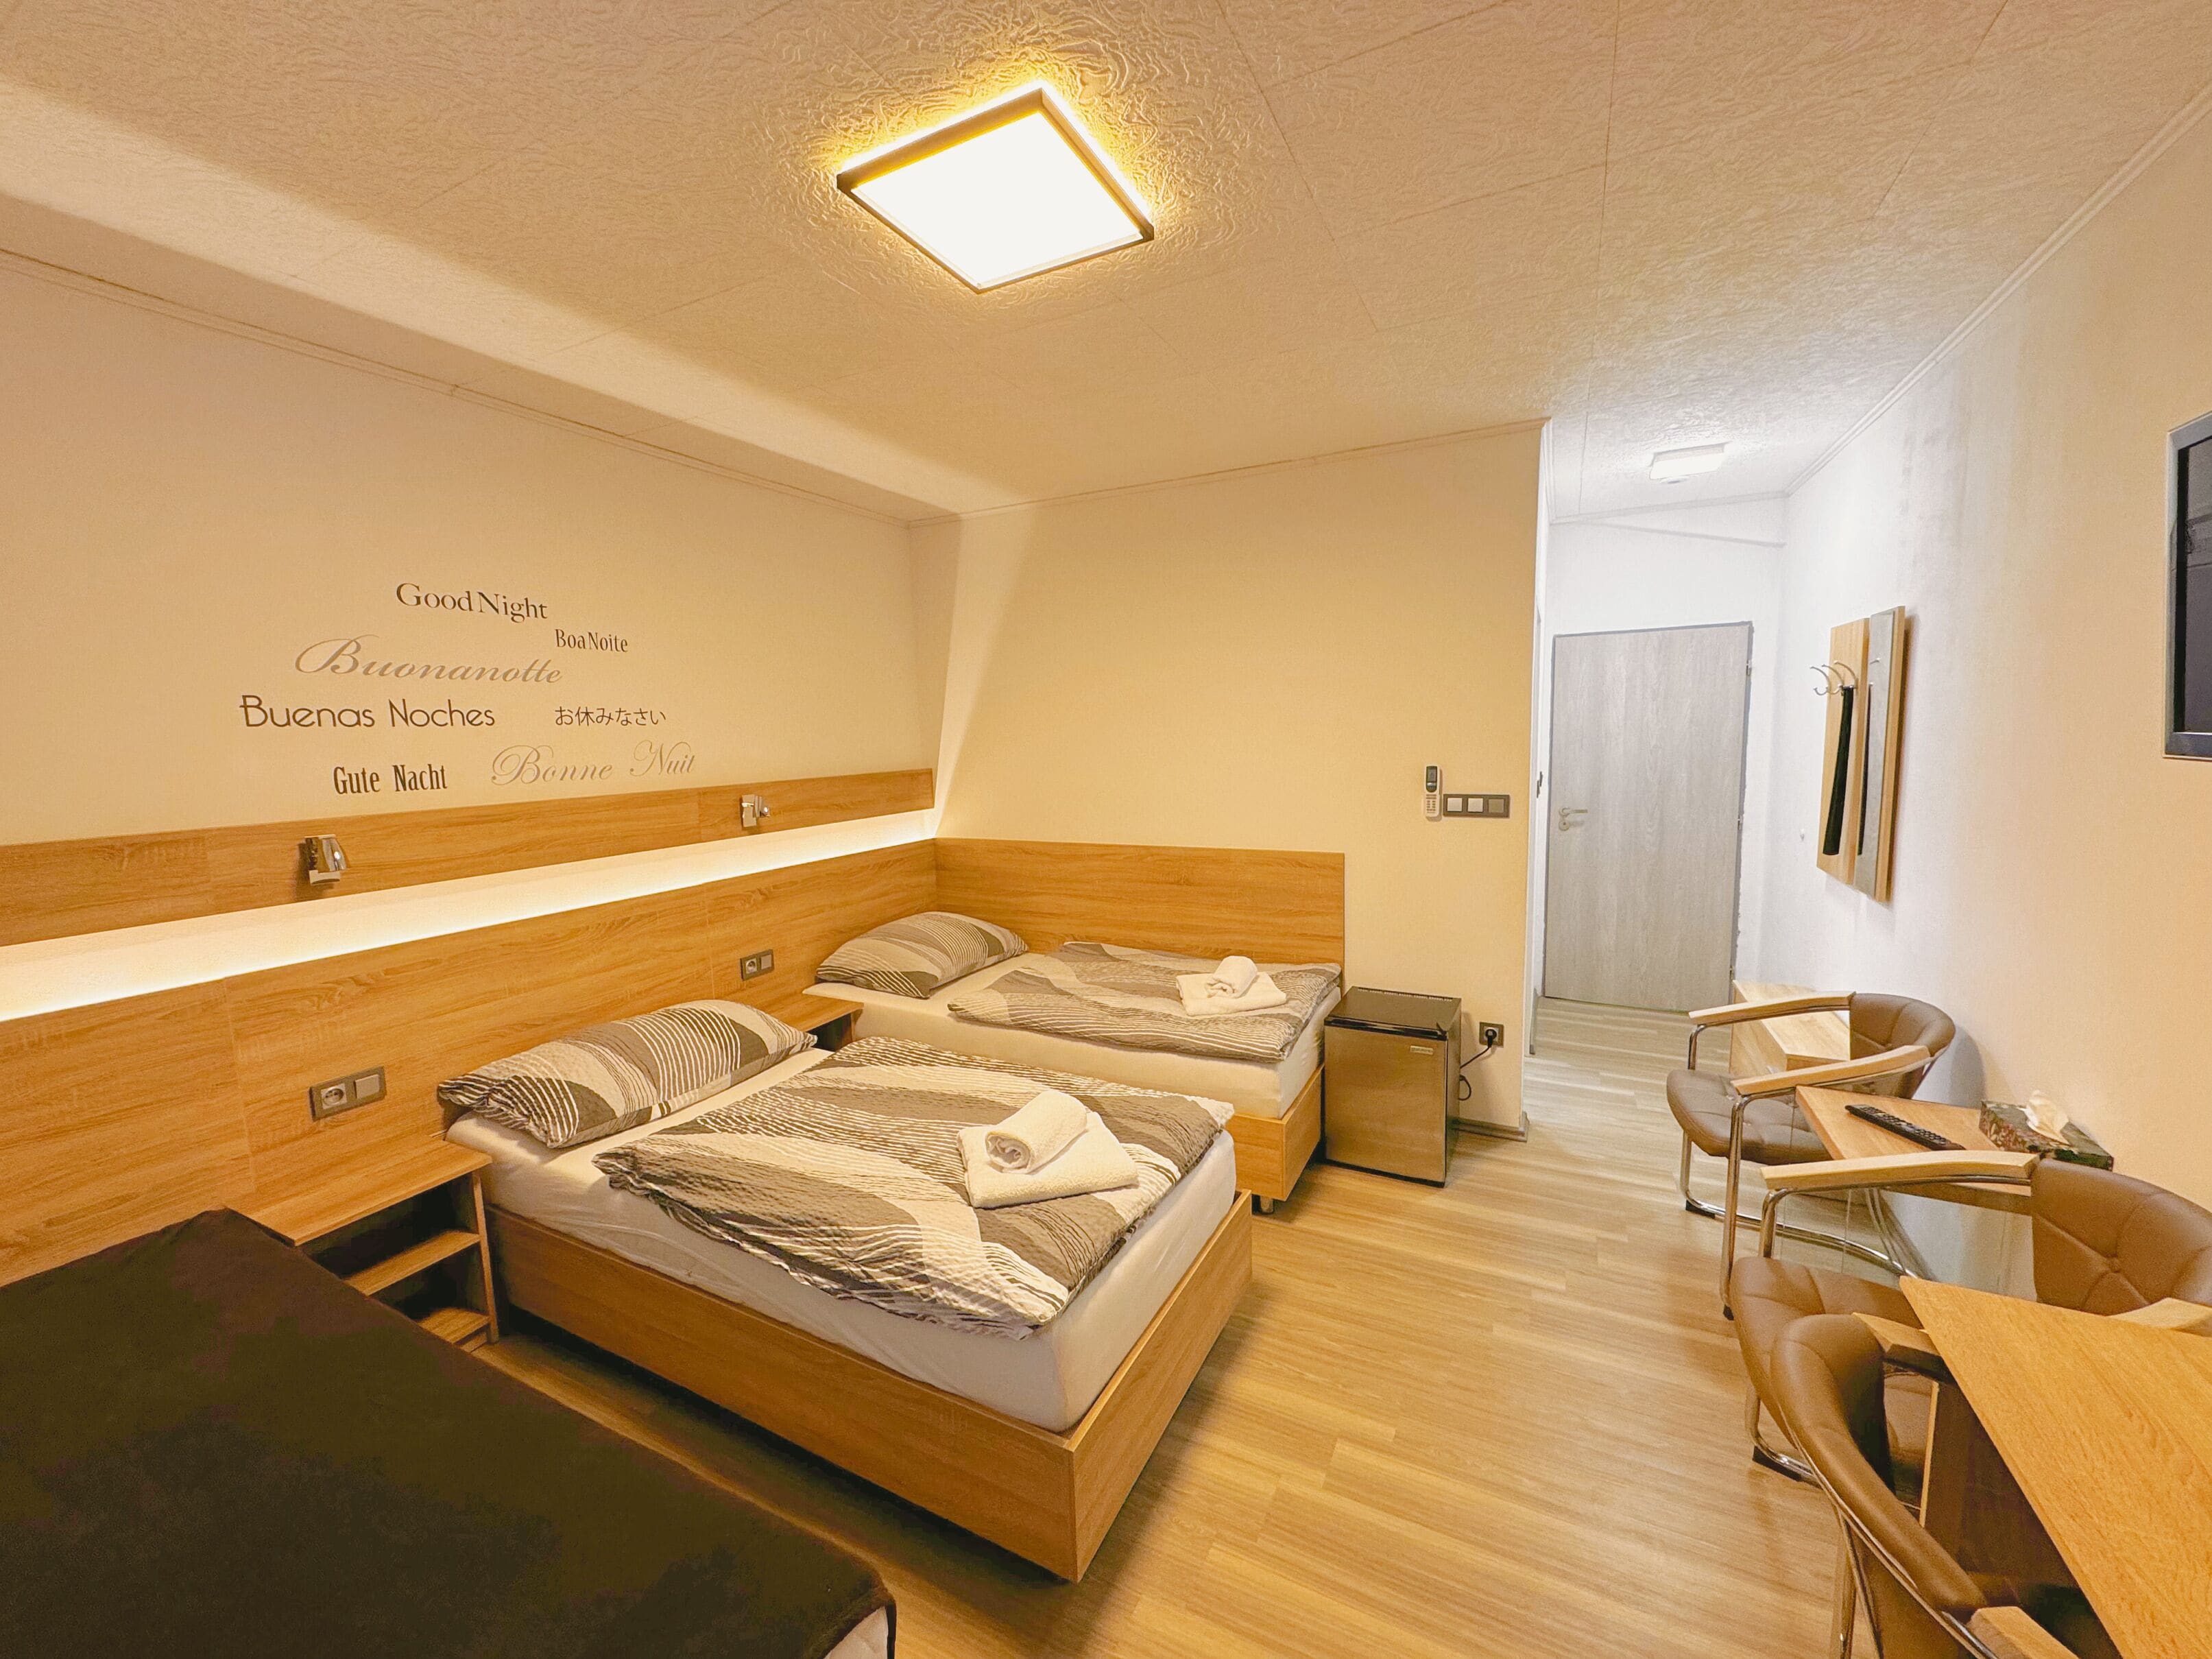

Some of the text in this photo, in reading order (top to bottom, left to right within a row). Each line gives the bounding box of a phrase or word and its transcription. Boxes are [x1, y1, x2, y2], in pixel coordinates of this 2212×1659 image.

[396, 582, 548, 623] Good Night
[295, 634, 563, 684] Buonanotte
[239, 695, 495, 727] Buenas Noches
[555, 706, 666, 726] お休みなさい
[333, 763, 448, 794] Gute Nacht
[491, 739, 695, 785] Bonne Nuit
